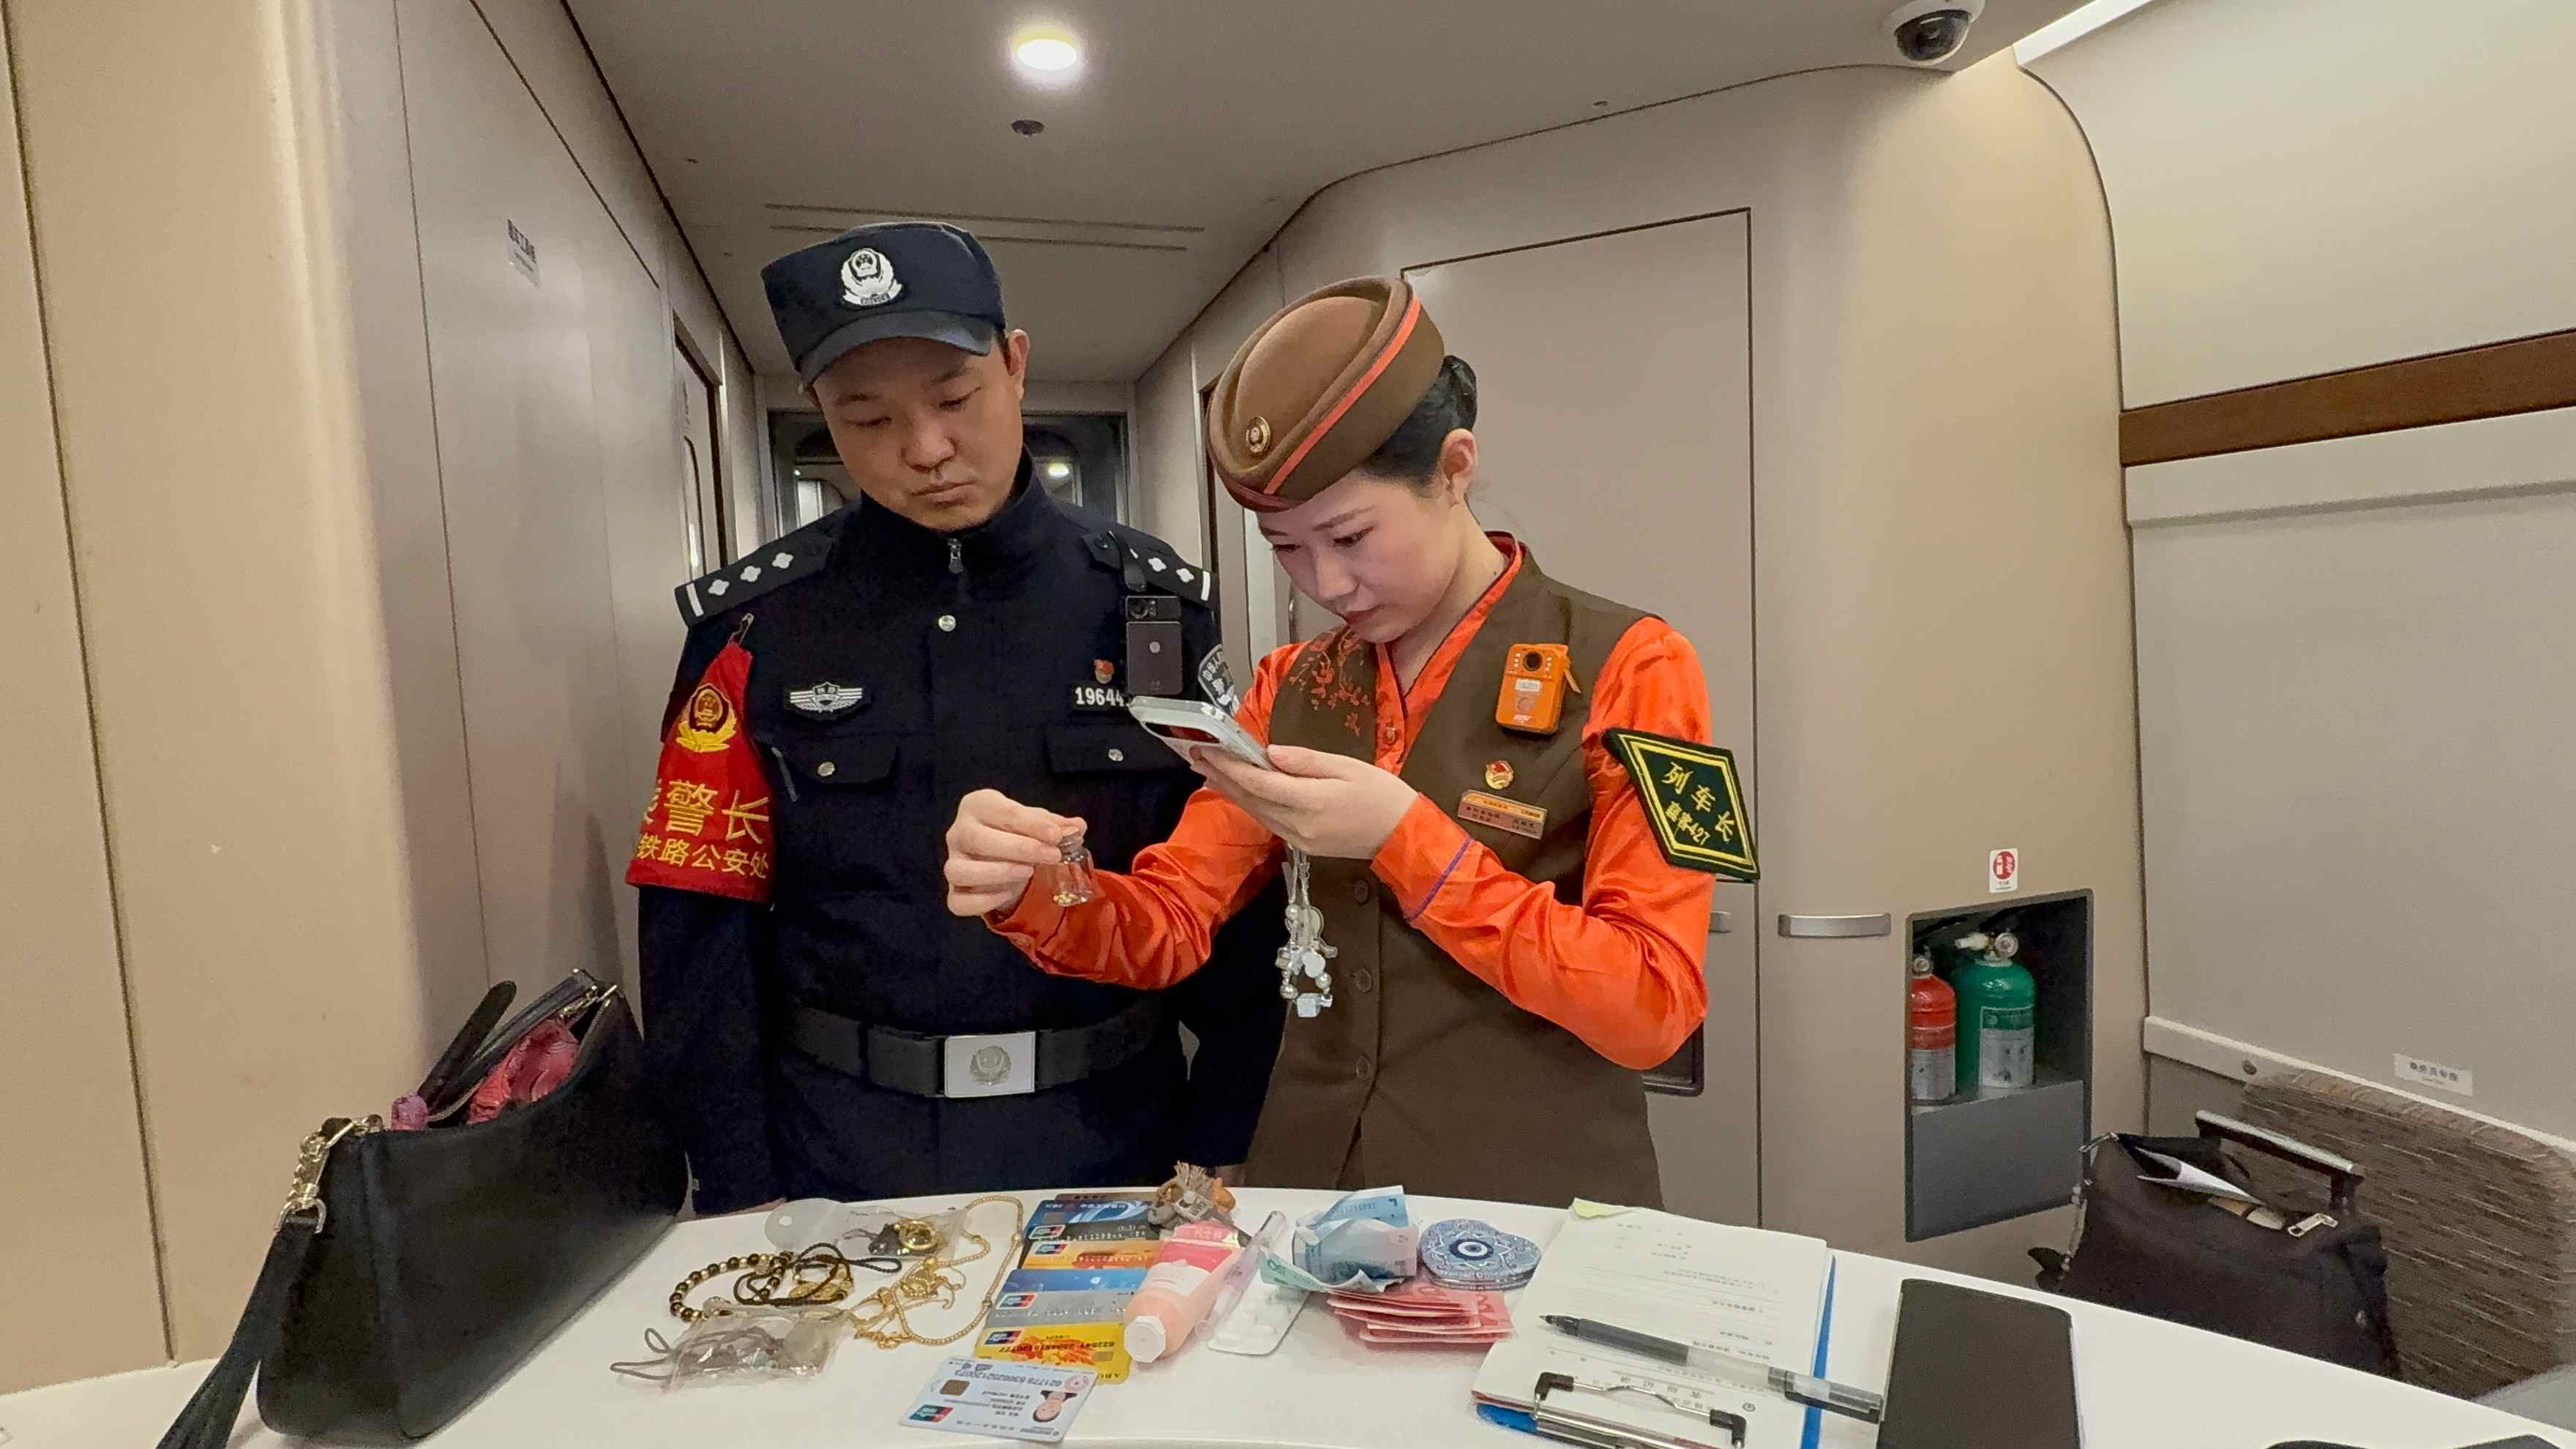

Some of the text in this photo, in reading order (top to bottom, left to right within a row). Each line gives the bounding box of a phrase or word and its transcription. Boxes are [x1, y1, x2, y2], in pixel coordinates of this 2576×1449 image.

[1074, 686, 1130, 708] 19644
[1660, 761, 1735, 843] 列车长
[636, 831, 769, 879] 铁路公安处
